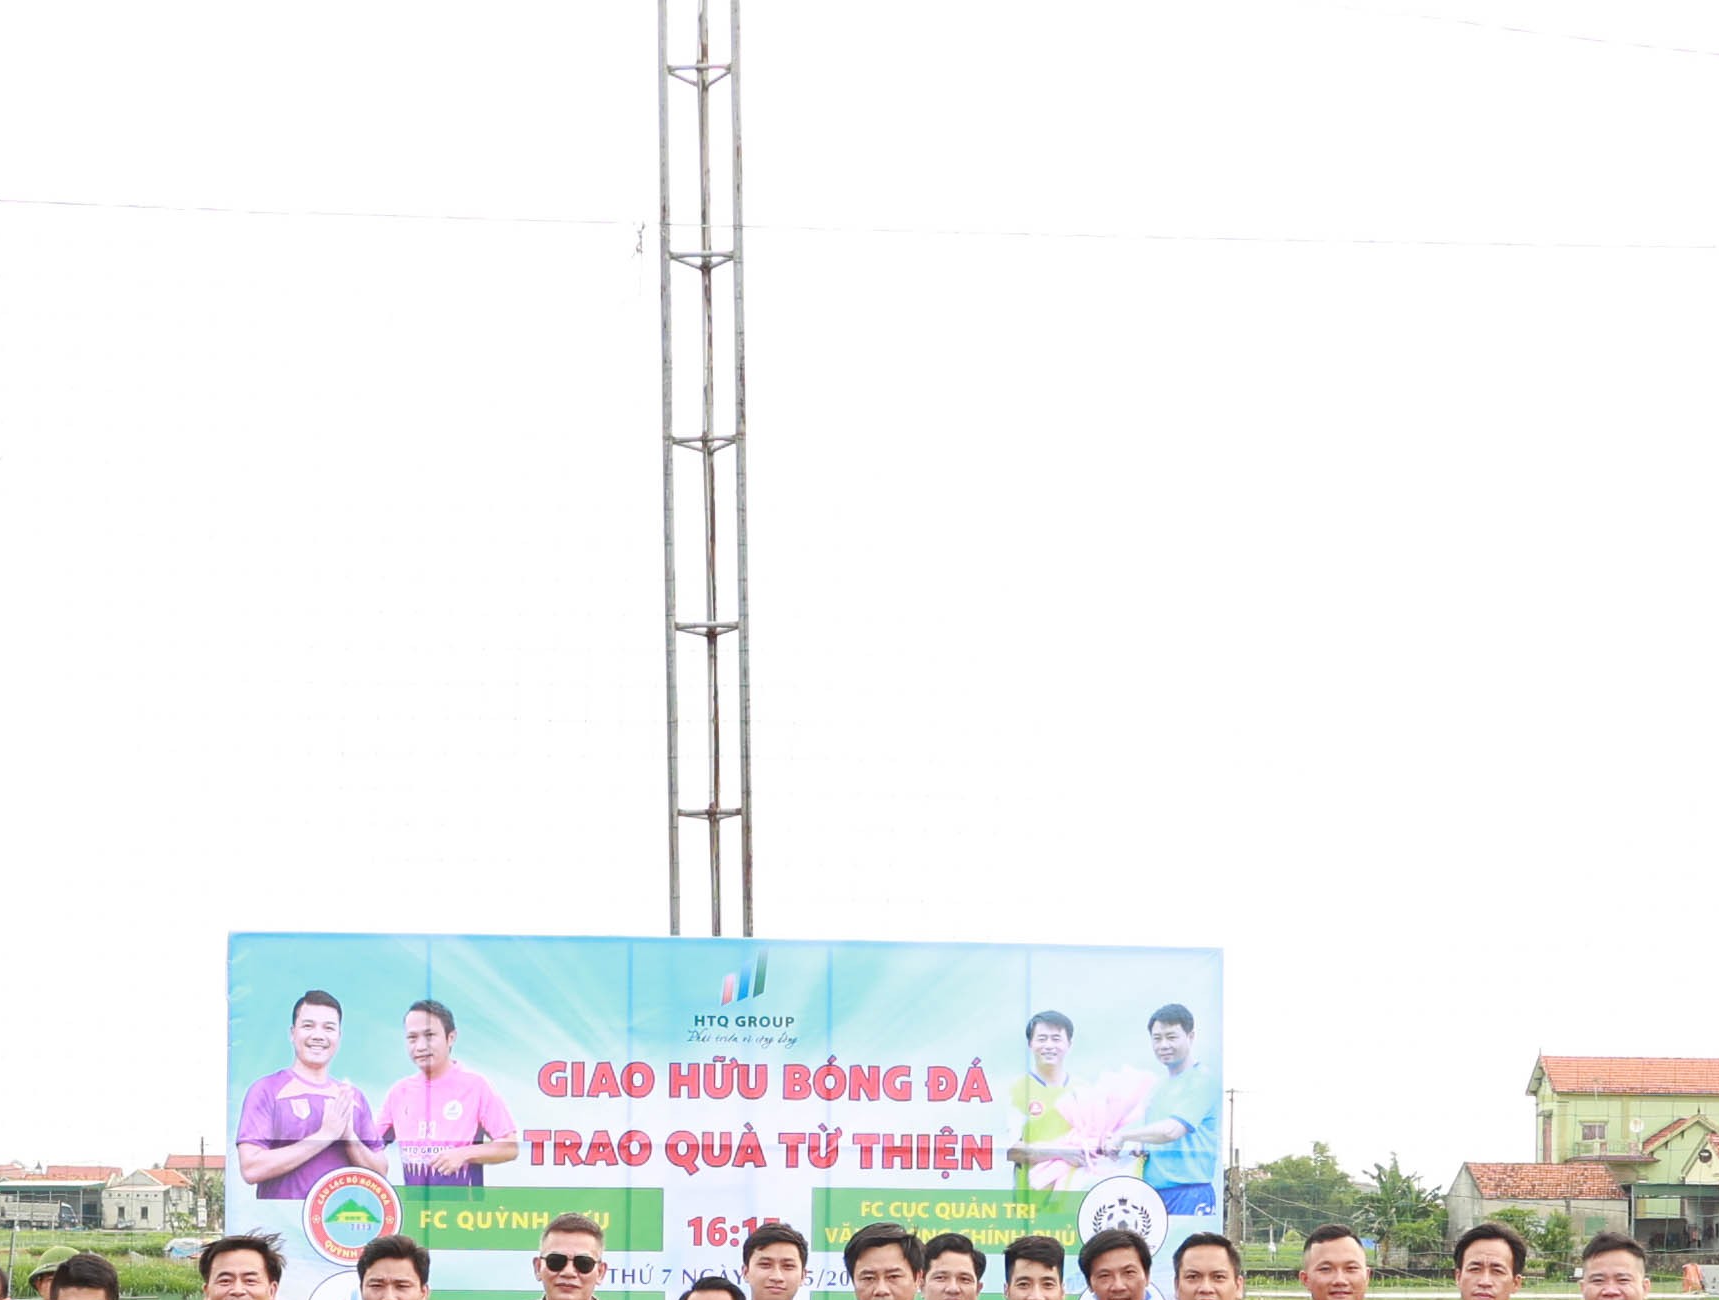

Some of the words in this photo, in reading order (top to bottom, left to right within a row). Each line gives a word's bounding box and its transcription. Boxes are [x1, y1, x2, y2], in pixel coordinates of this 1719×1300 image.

[694, 1015, 729, 1029] HTQ
[735, 1015, 796, 1029] GROUP
[537, 1059, 656, 1099] GIAO
[668, 1056, 768, 1101] HỮU
[783, 1056, 913, 1103] BÓNG
[926, 1057, 994, 1104] ĐÁ
[523, 1129, 653, 1167] TRAO
[664, 1123, 768, 1176] QUÀ
[778, 1123, 842, 1170] TỪ
[852, 1126, 994, 1180] THIỆN
[419, 1210, 447, 1230] FC
[457, 1206, 551, 1231] QUỲNH
[860, 1201, 884, 1217] FC
[888, 1202, 930, 1222] CỤC
[934, 1196, 997, 1221] QUẢN
[1003, 1202, 1038, 1225] TRỊ
[687, 1216, 781, 1247] 16:1
[825, 1226, 852, 1244] VĂ
[609, 1263, 655, 1285] THỨ
[661, 1268, 672, 1285] 7
[804, 1270, 851, 1287] 5/20
